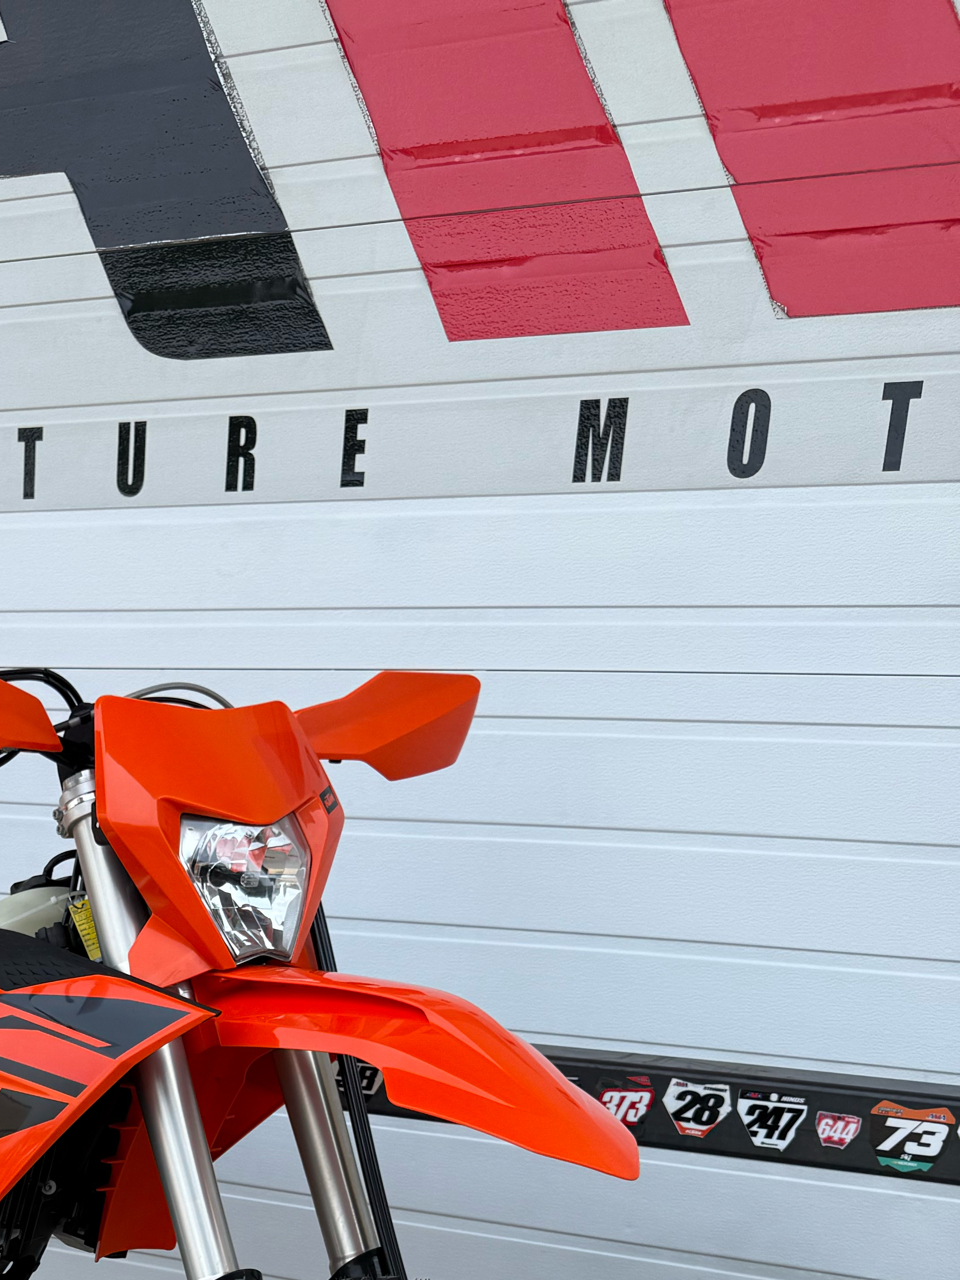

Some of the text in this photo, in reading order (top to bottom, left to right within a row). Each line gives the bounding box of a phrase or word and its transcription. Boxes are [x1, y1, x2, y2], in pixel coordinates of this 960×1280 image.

[601, 1091, 652, 1122] 373
[671, 1090, 725, 1126] 28
[745, 1103, 806, 1141] 247
[819, 1118, 858, 1142] 644
[875, 1117, 950, 1157] 73
